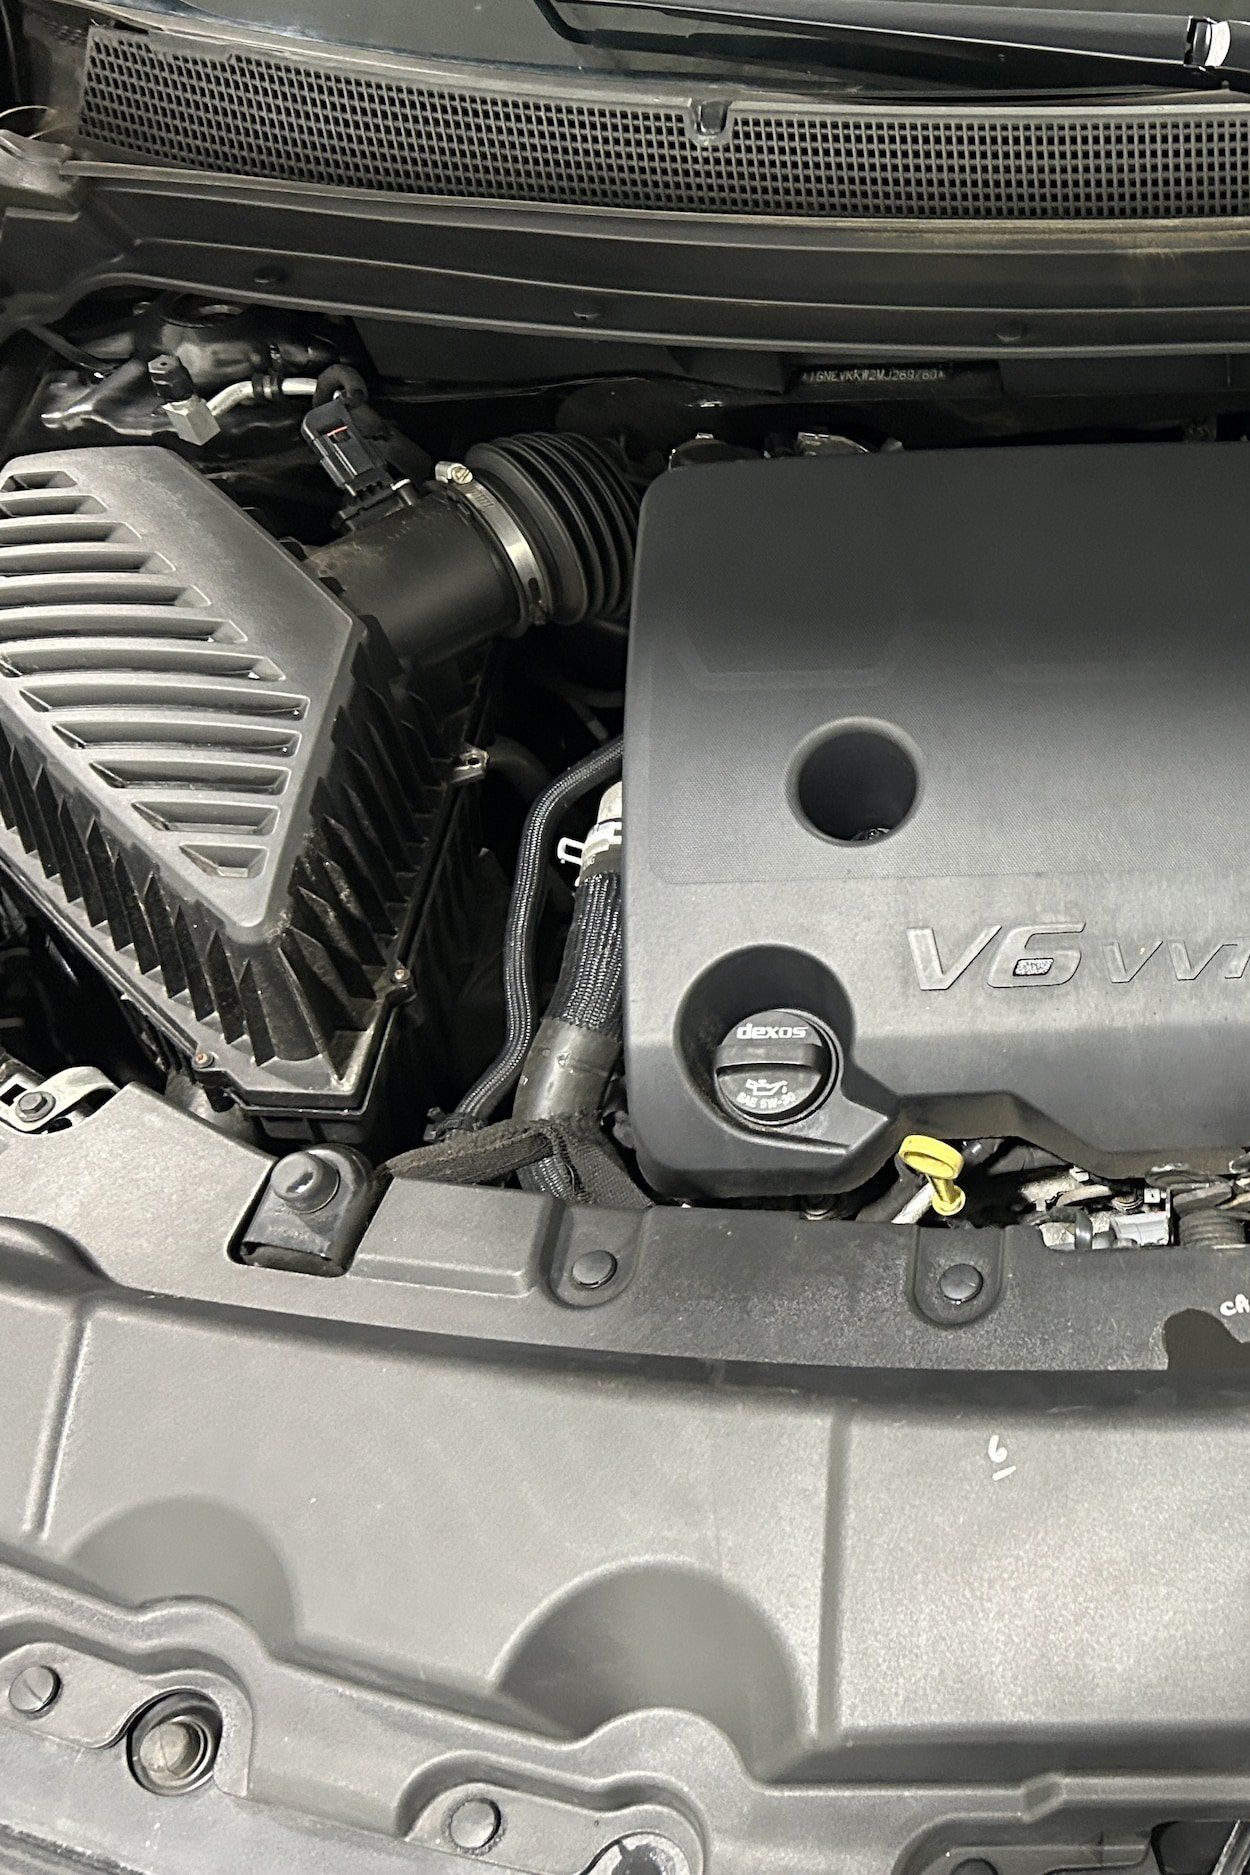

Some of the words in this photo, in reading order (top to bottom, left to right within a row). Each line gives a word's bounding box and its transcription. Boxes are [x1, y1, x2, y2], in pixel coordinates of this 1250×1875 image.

[906, 922, 1087, 991] V6
[737, 1023, 808, 1039] dexos
[736, 1092, 759, 1108] SAE
